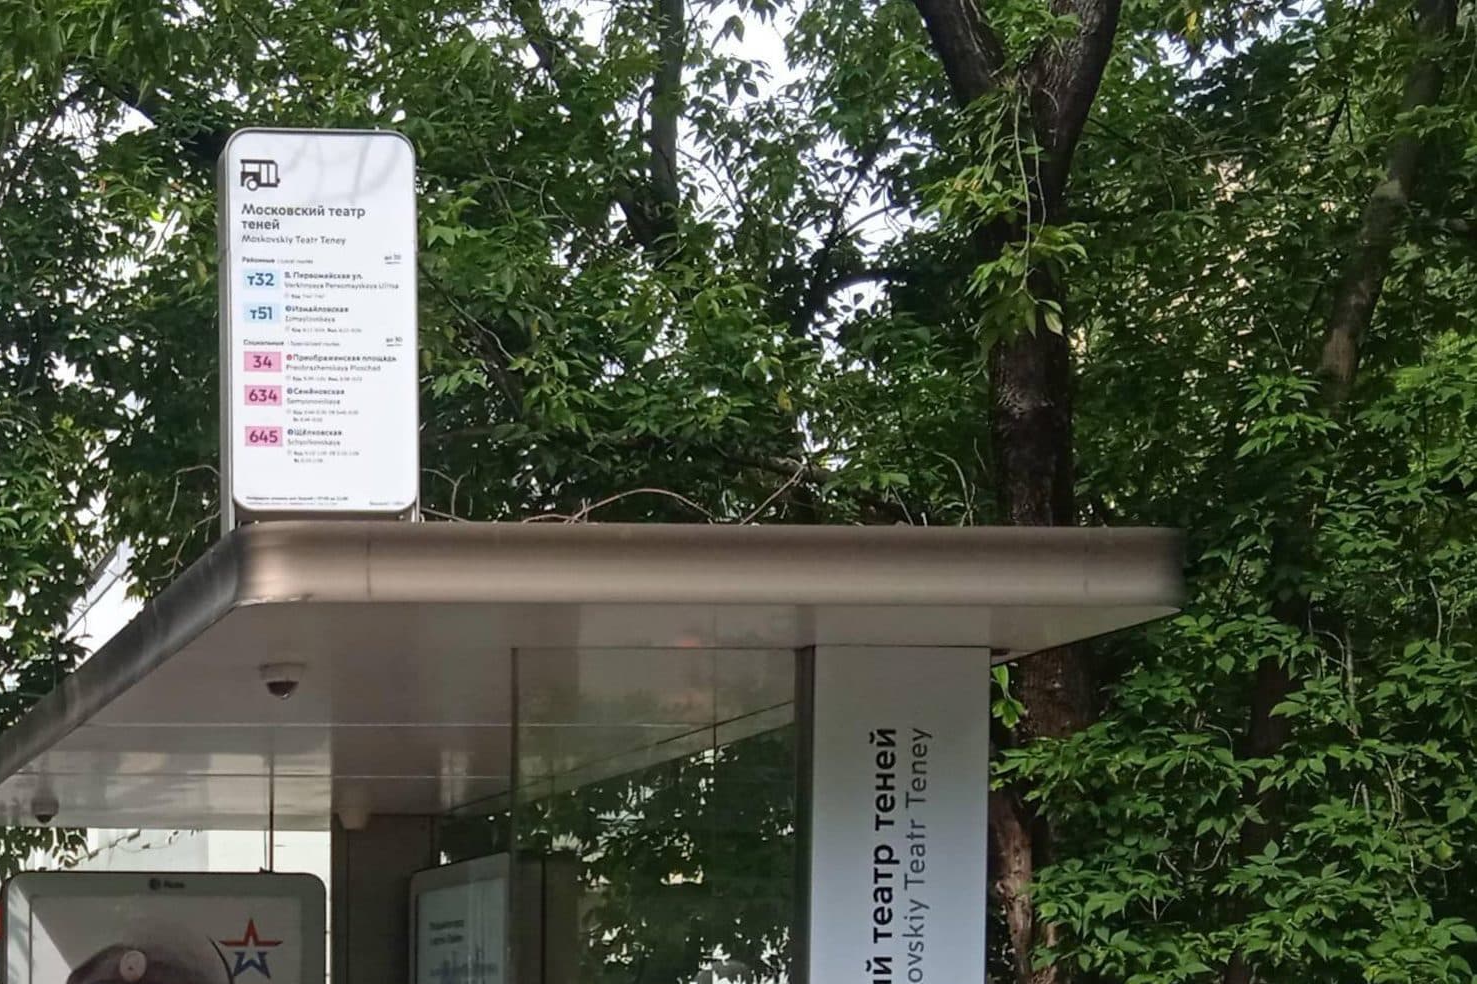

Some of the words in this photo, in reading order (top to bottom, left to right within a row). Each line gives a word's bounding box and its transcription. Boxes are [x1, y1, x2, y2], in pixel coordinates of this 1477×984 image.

[242, 204, 325, 217] Московский
[328, 207, 366, 220] театр
[242, 218, 280, 230] теней
[242, 235, 293, 246] Moskovskiy
[247, 272, 275, 287] т32
[250, 306, 273, 320] т51
[252, 355, 273, 369] 34
[248, 389, 279, 403] 634
[248, 430, 279, 444] 645
[905, 727, 933, 809] Teney
[869, 727, 898, 832] теней
[904, 819, 927, 891] Teatr
[872, 844, 901, 944] театр
